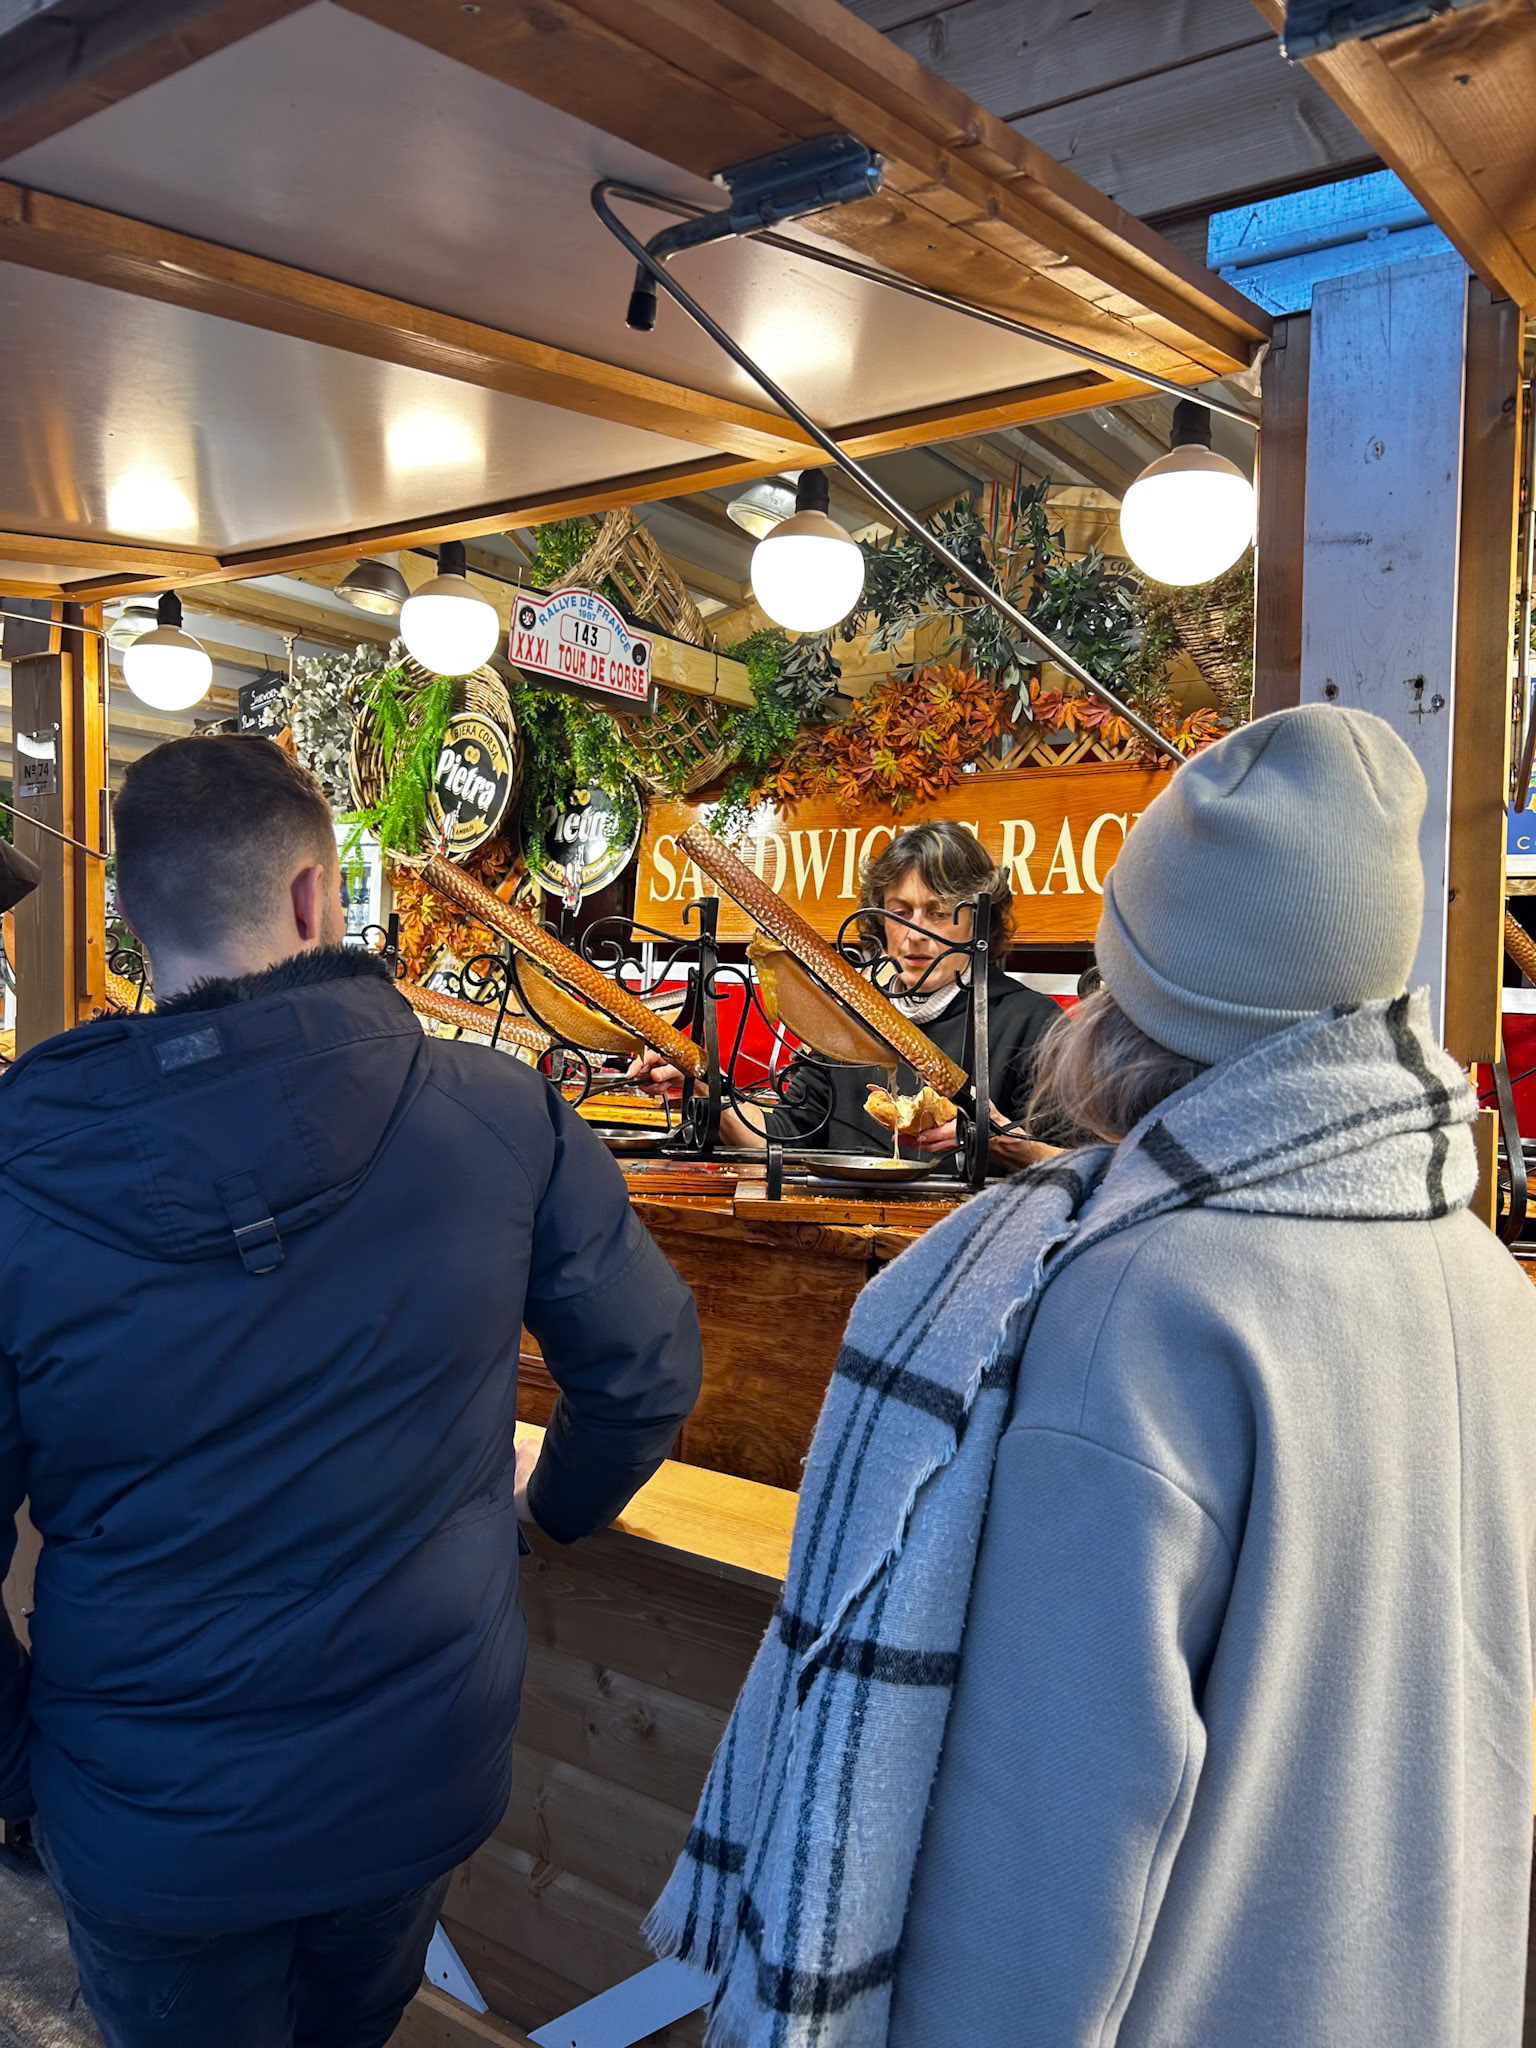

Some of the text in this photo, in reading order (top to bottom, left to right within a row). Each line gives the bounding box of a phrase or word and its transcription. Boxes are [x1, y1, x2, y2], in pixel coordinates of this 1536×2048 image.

[538, 596, 631, 653] RALLYE DE FRANCE
[574, 621, 599, 647] 143
[578, 609, 597, 622] 1987
[515, 632, 645, 693] XXXI TOUR DE CORSE
[453, 724, 499, 761] BIERA CORSA
[38, 763, 49, 777] 74
[435, 748, 497, 812] Pietra
[998, 811, 1146, 897] RAC
